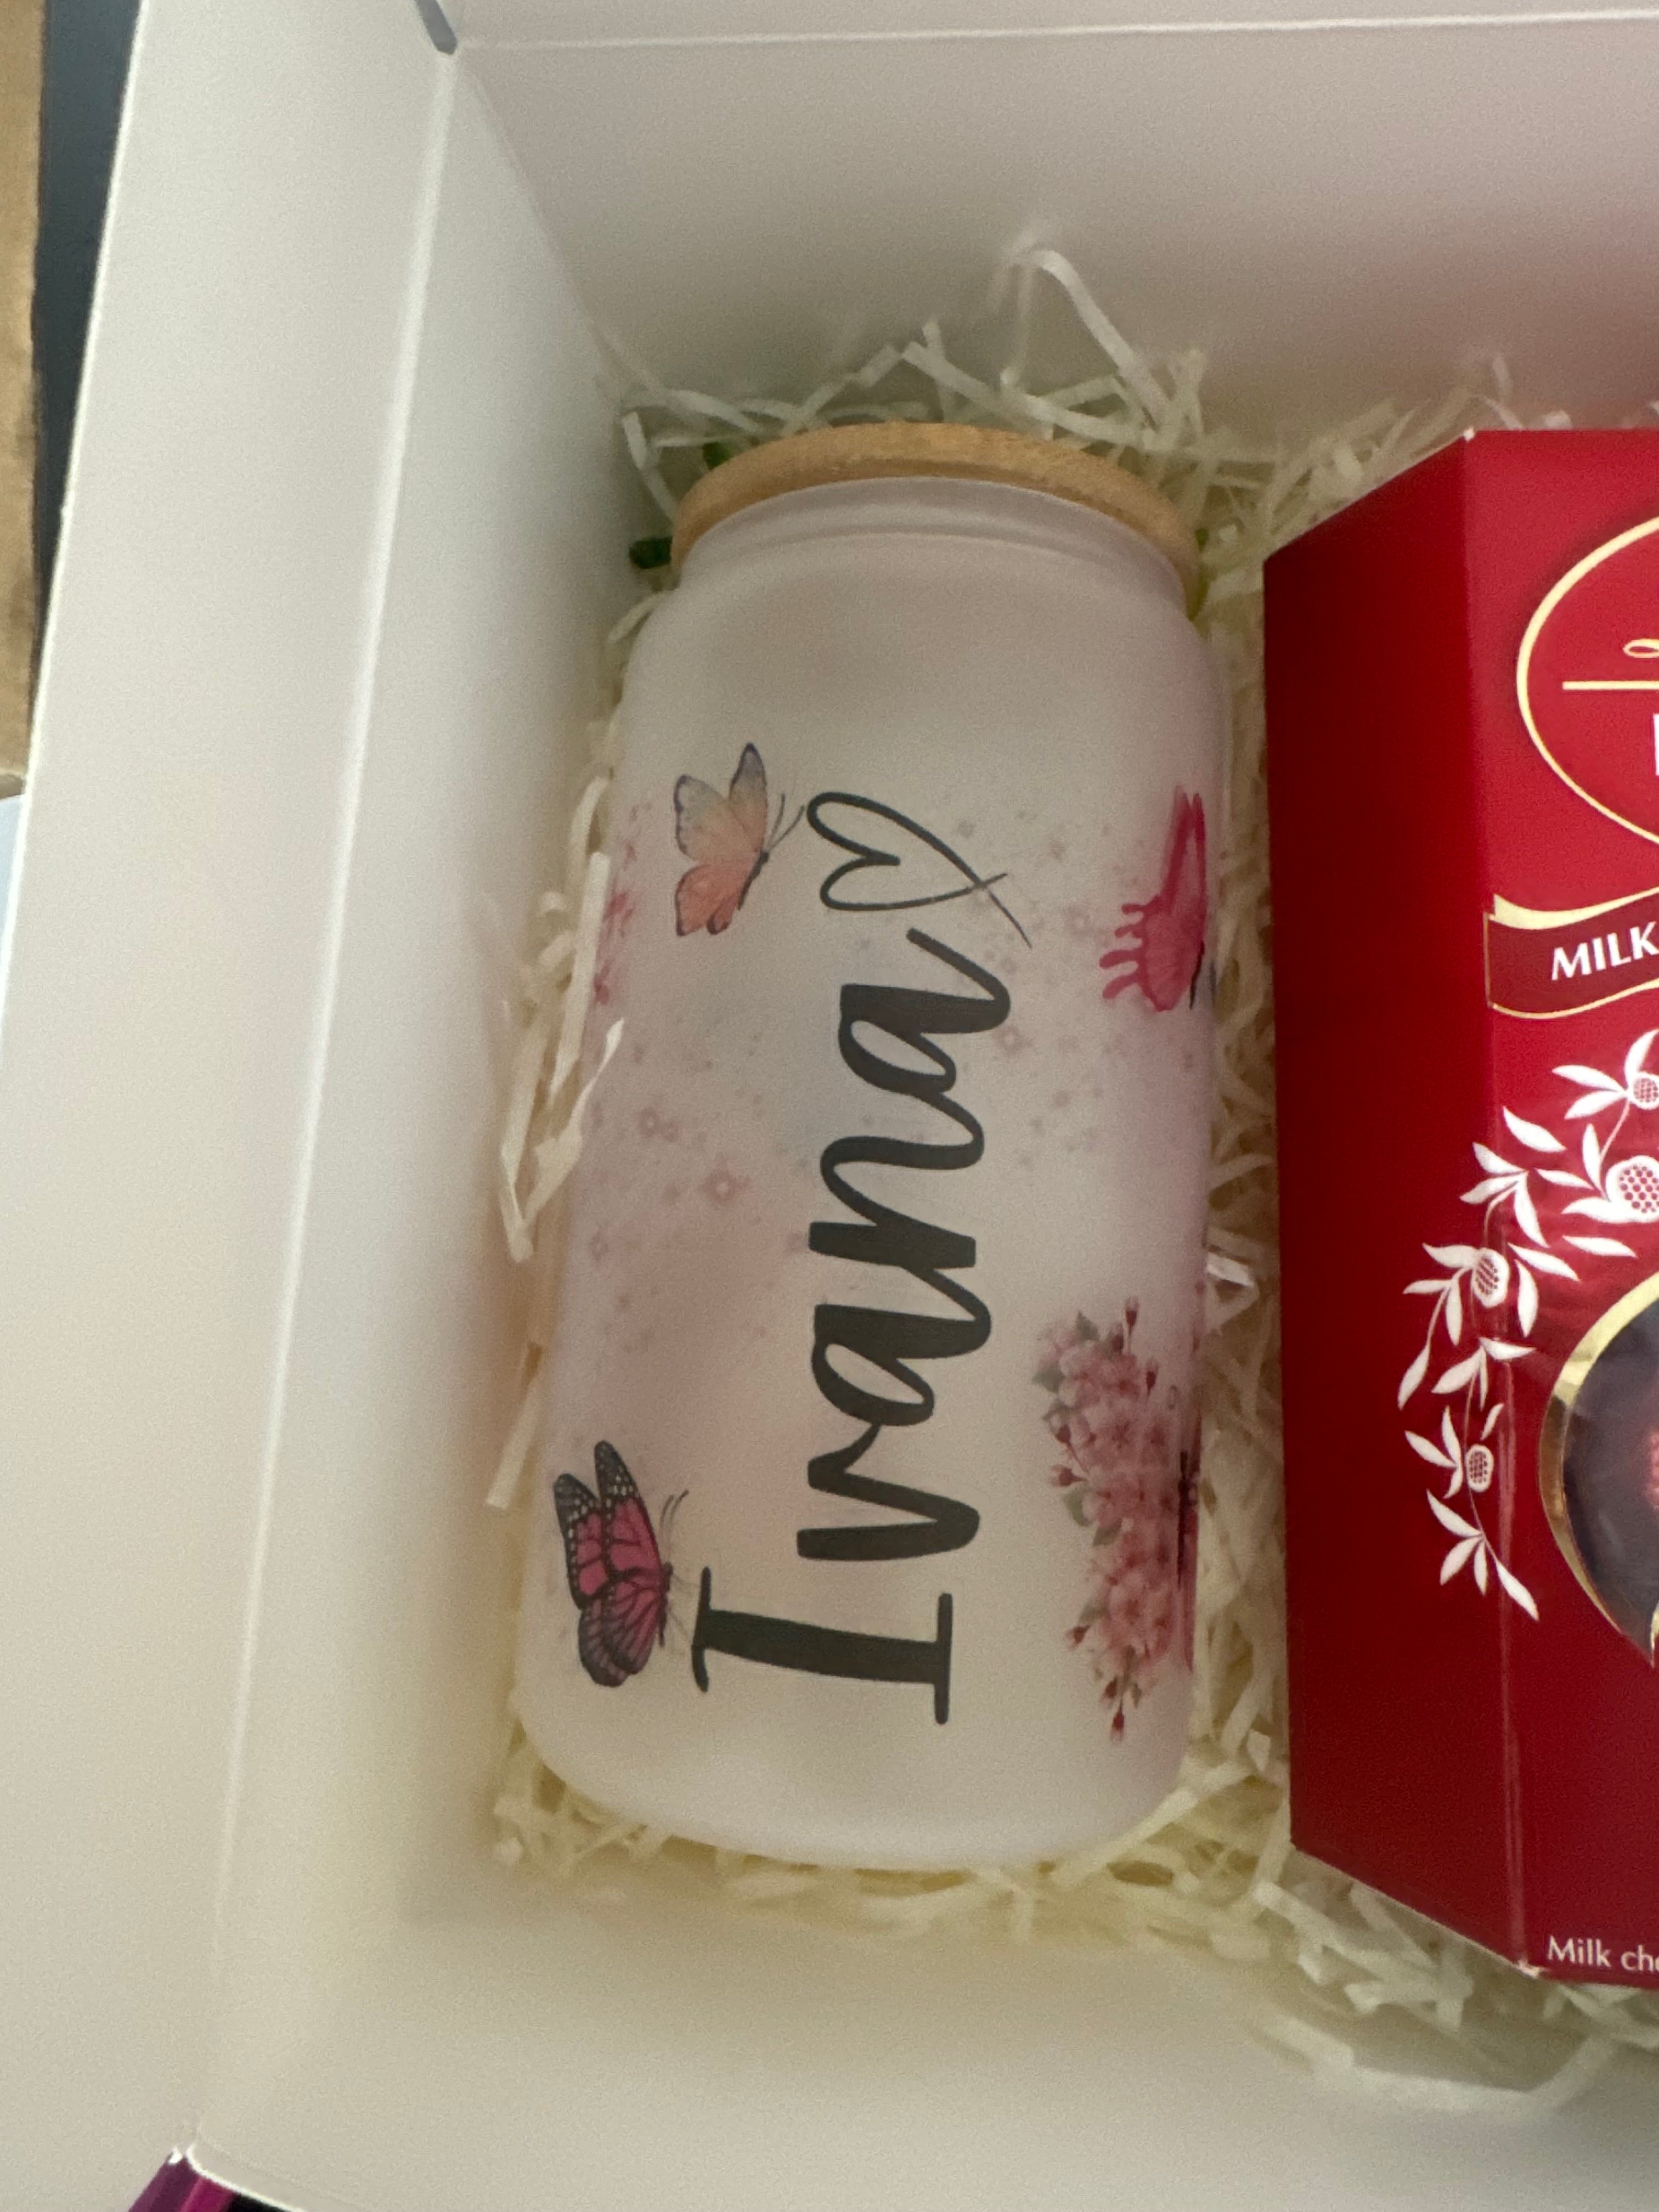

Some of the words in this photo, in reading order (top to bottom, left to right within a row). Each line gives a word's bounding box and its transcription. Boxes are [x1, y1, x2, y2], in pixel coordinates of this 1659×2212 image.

[1551, 920, 1659, 981] MILK
[691, 928, 1010, 1725] Ivana
[1547, 1934, 1612, 1967] Milk
[1620, 1943, 1659, 1974] ch
